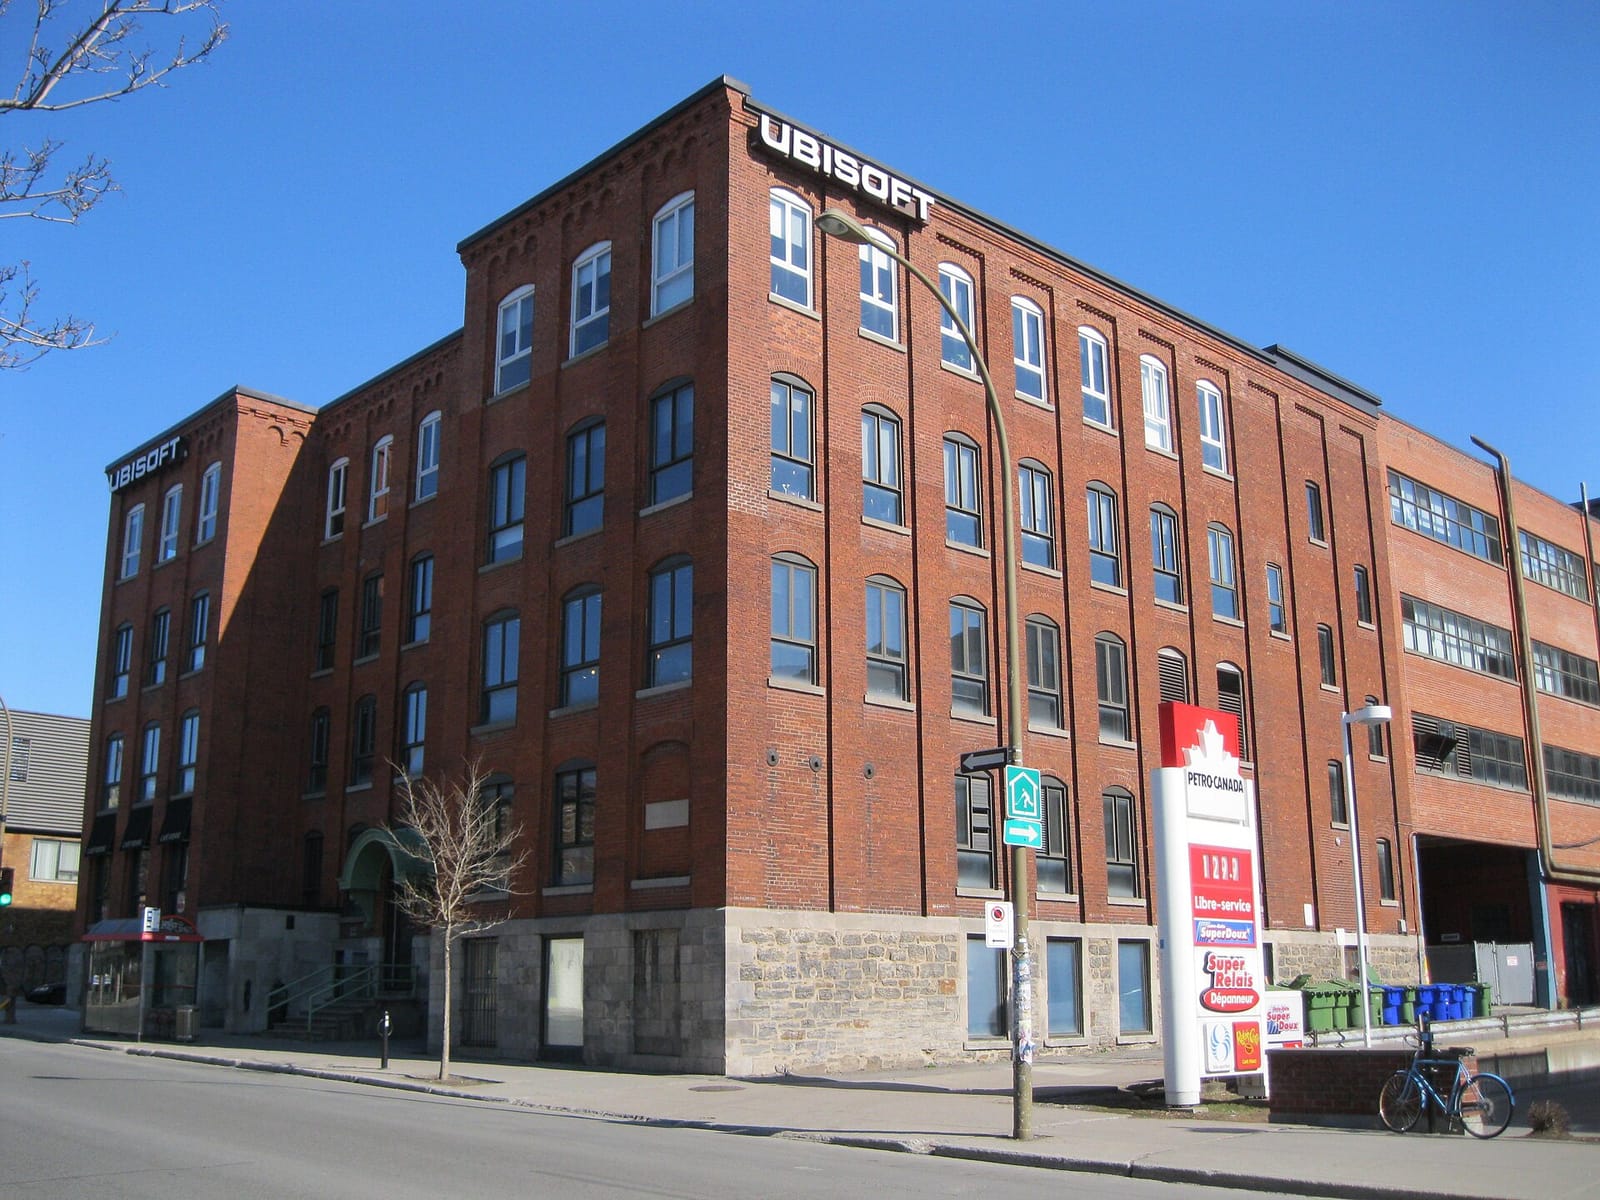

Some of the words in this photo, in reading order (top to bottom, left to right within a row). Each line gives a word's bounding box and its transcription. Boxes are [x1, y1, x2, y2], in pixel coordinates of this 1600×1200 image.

[760, 112, 935, 221] UBISOFT
[109, 435, 181, 493] UBISOFT
[1195, 896, 1251, 912] Libre-service
[1200, 926, 1248, 940] SuperDoux
[1208, 955, 1245, 974] Super
[1215, 971, 1253, 987] Relais
[1211, 992, 1254, 1007] Dépanneur
[1267, 1012, 1290, 1021] Super
[1279, 1021, 1298, 1029] Doux
